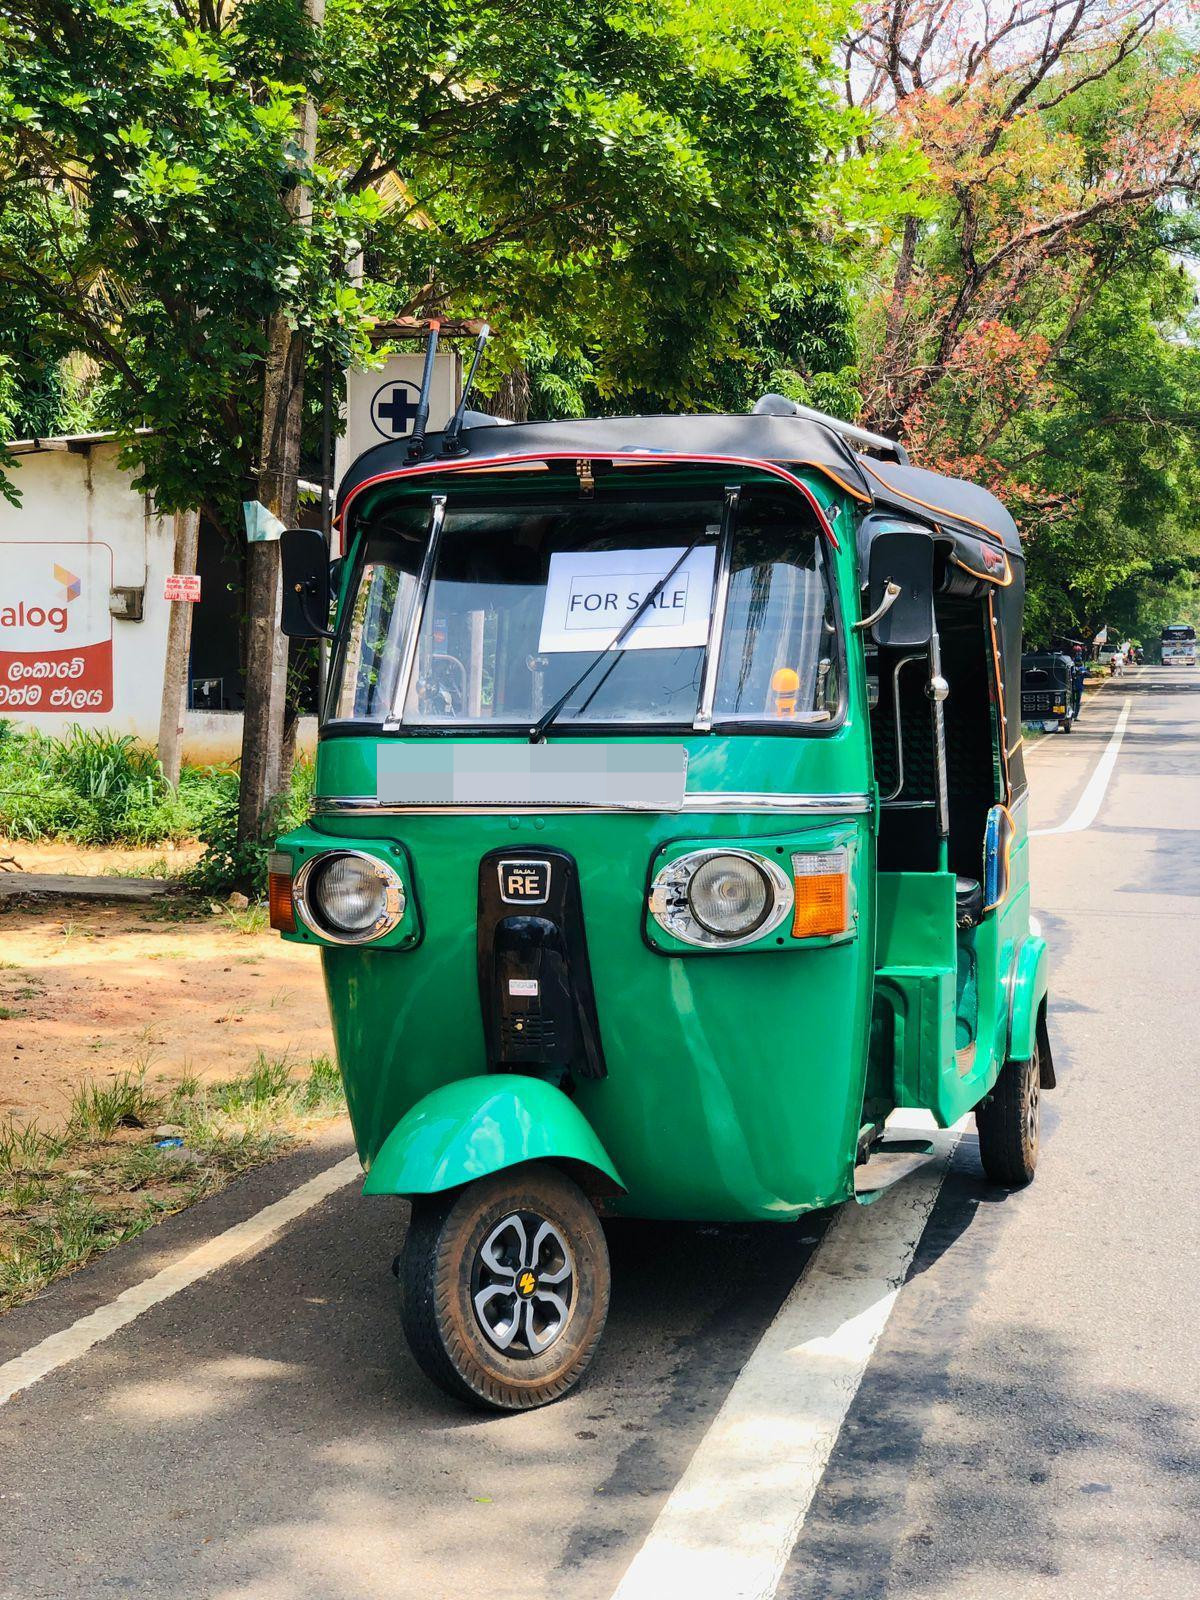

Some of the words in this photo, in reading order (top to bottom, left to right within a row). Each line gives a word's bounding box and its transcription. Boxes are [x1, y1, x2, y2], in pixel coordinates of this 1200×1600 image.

[570, 593, 618, 612] FOR
[1, 601, 68, 633] alog
[8, 657, 85, 681] ලංකාවේ
[50, 686, 103, 709] ජාලය
[508, 875, 540, 895] RE
